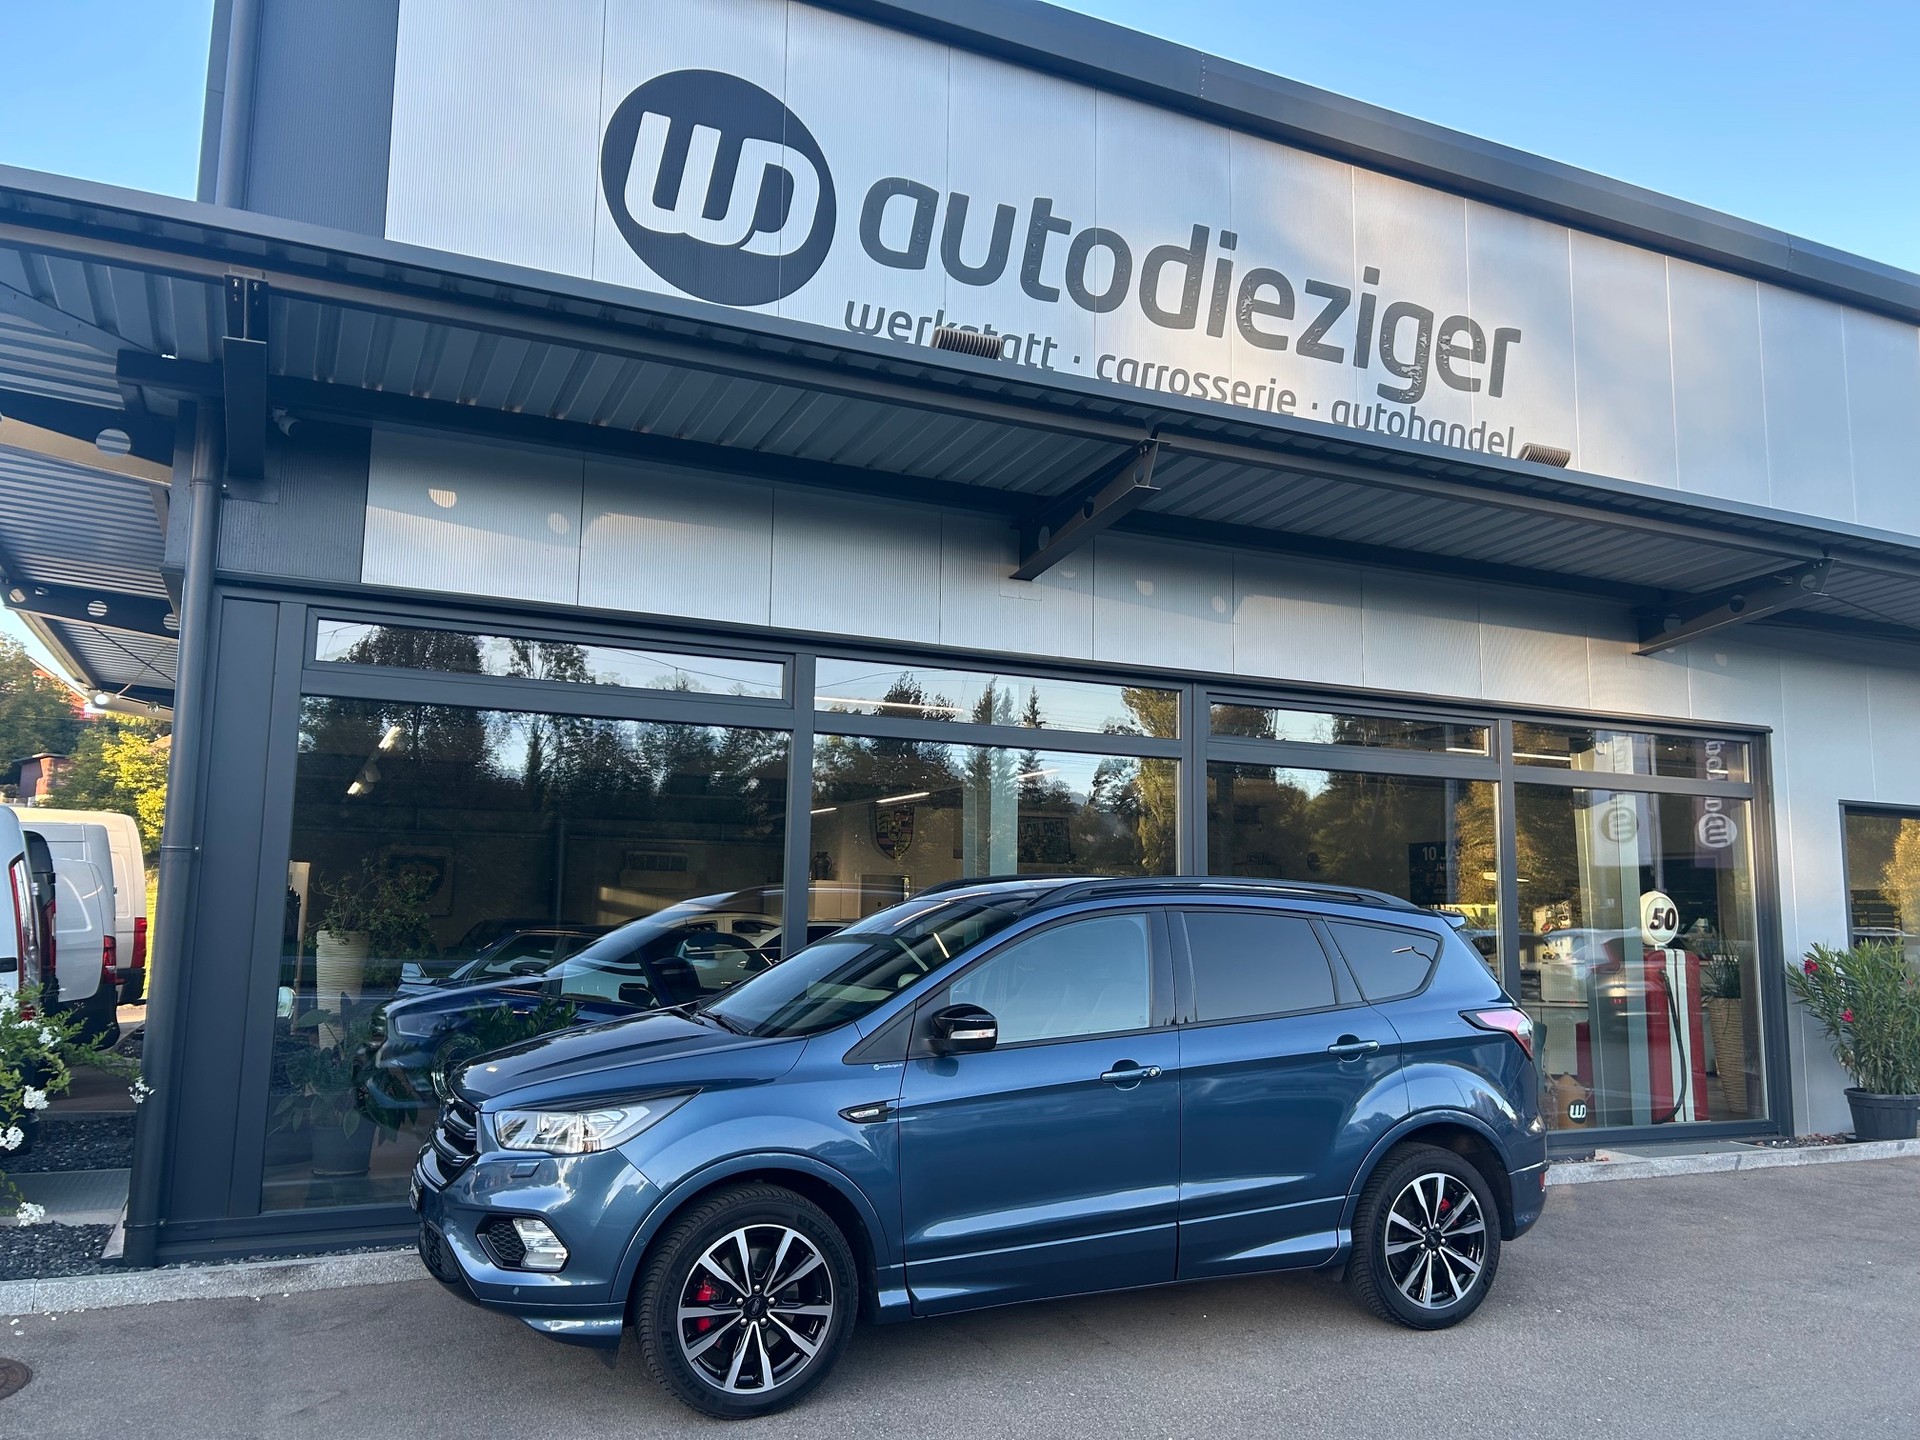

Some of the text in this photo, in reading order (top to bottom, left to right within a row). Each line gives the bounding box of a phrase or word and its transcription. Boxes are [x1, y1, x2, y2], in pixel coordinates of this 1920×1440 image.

[859, 176, 1522, 404] autodieziger
[845, 300, 1515, 458] weratt carrosserie autohandel
[1422, 847, 1437, 861] 10
[1649, 907, 1677, 931] 50
